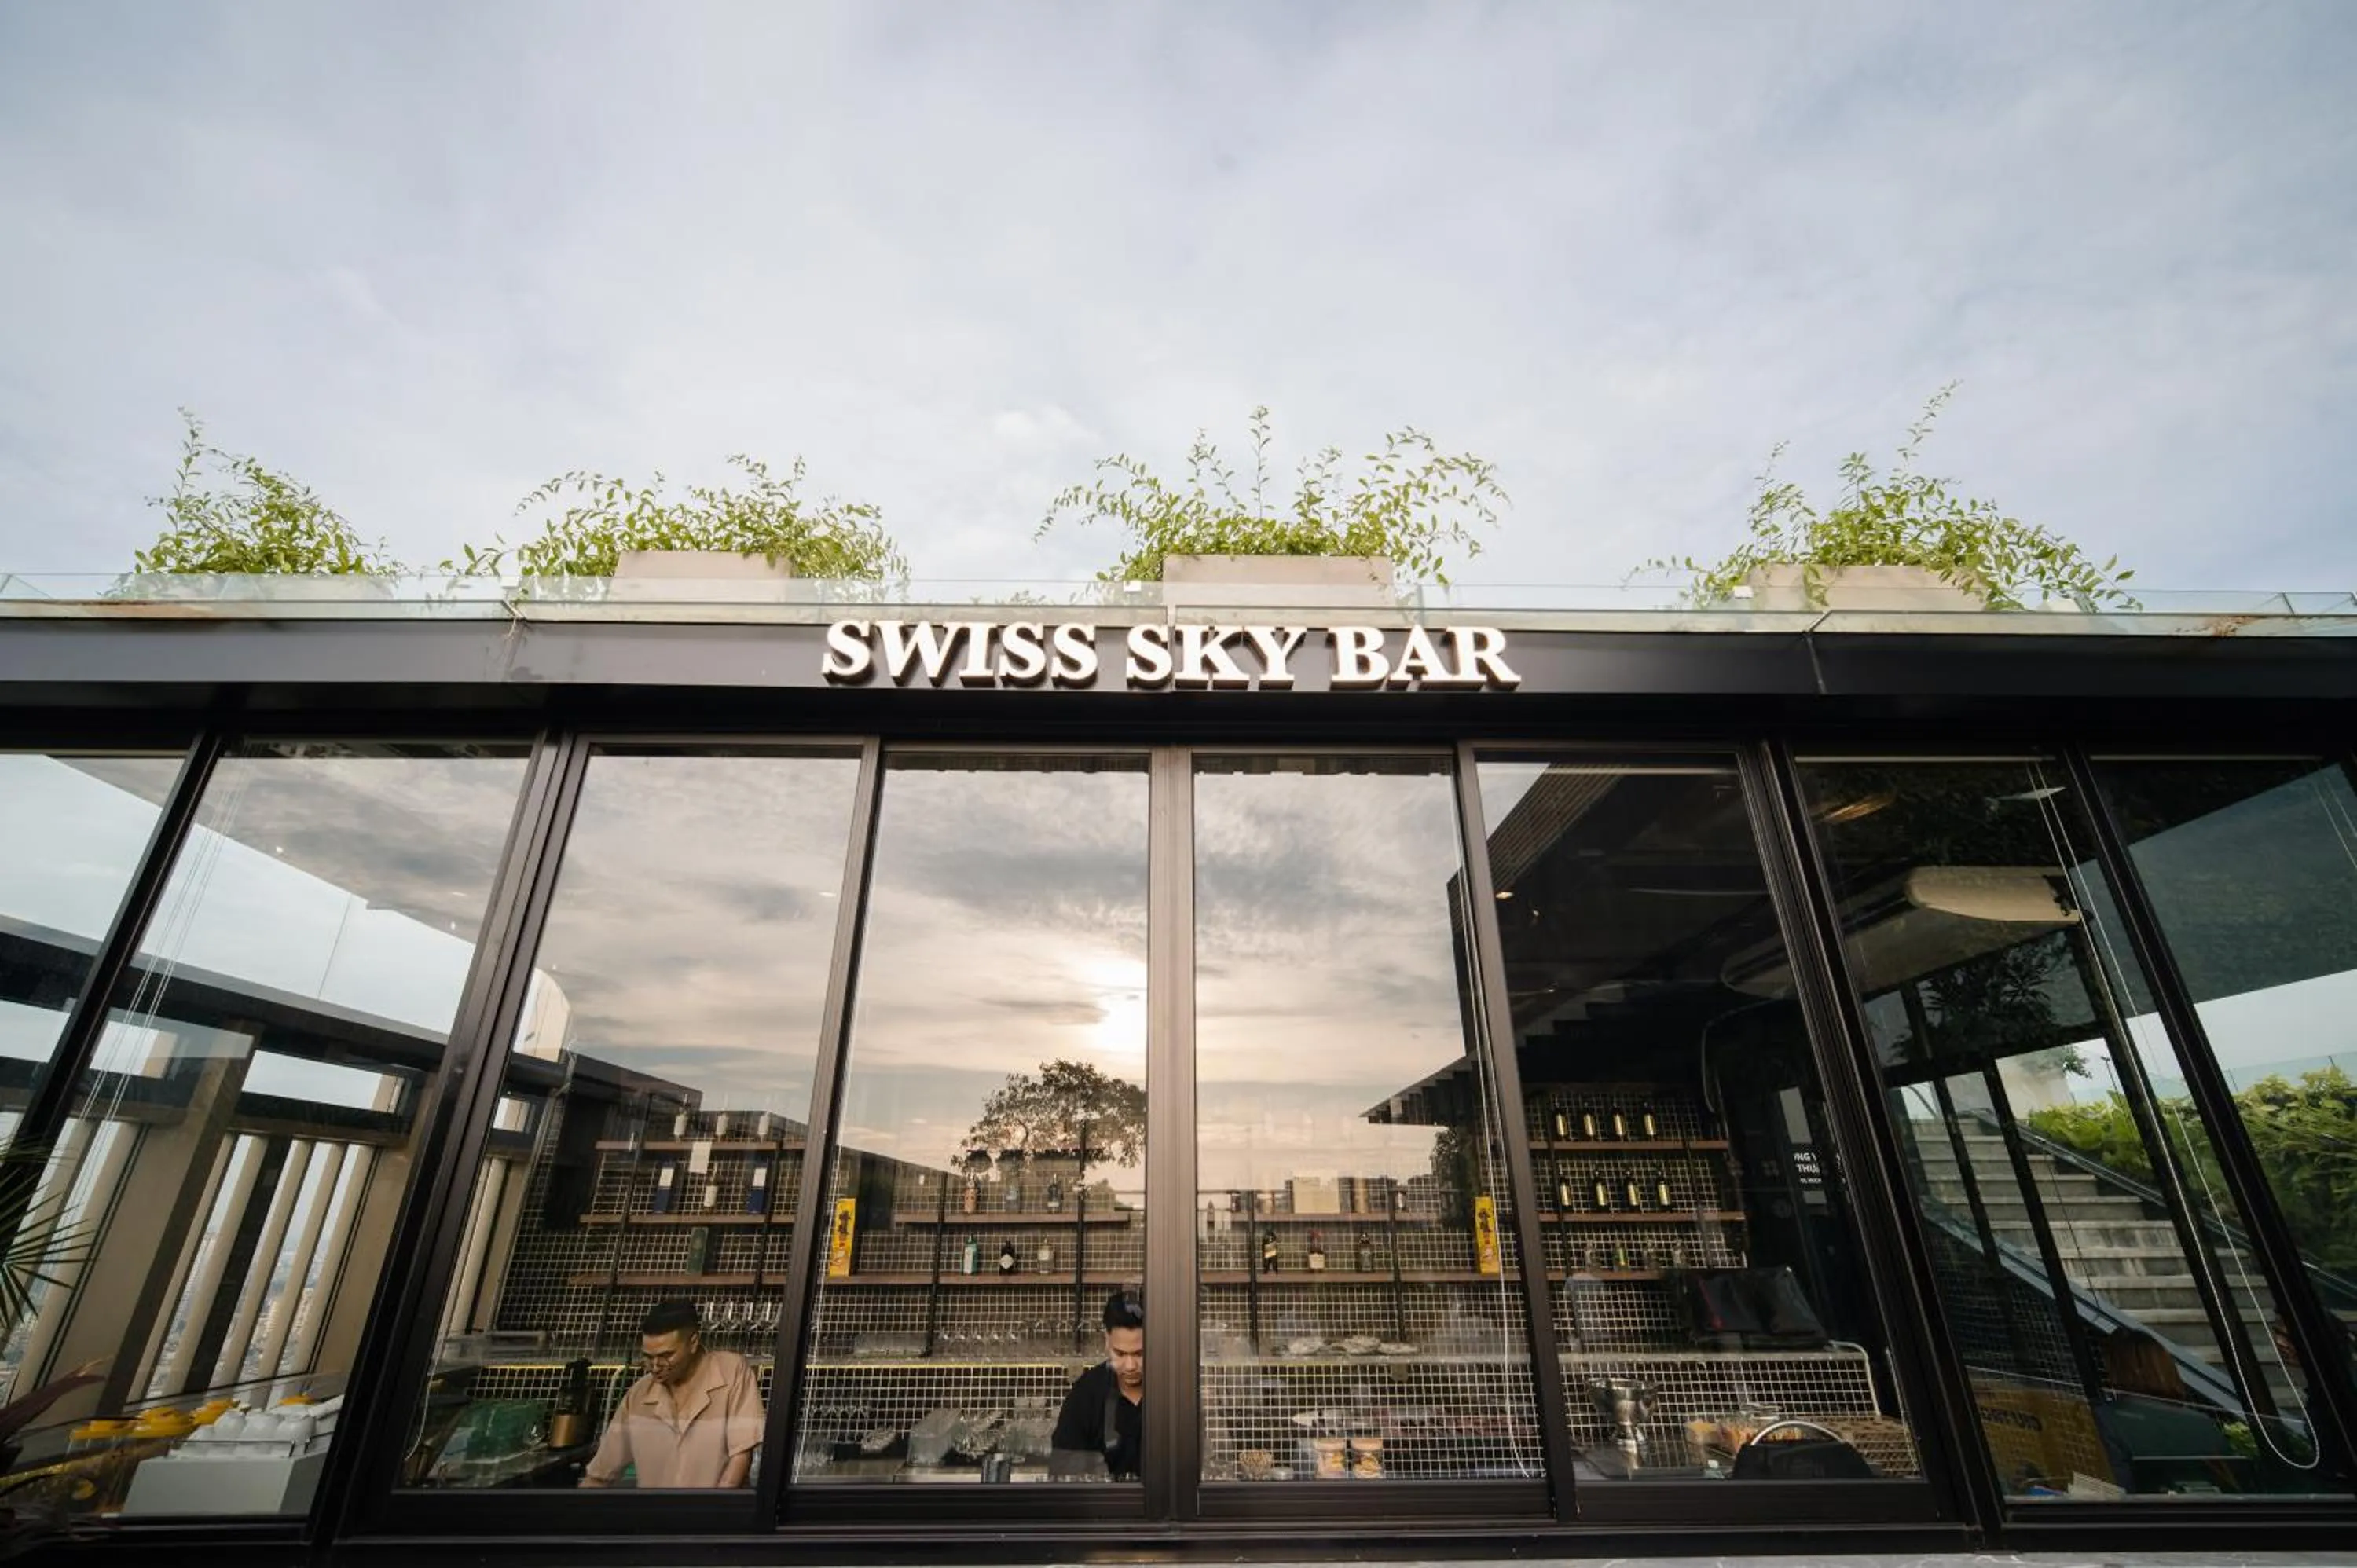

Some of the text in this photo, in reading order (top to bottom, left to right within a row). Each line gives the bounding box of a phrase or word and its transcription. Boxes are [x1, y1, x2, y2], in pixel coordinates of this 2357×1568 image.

[822, 619, 1522, 686] SWISS SKY BAR
